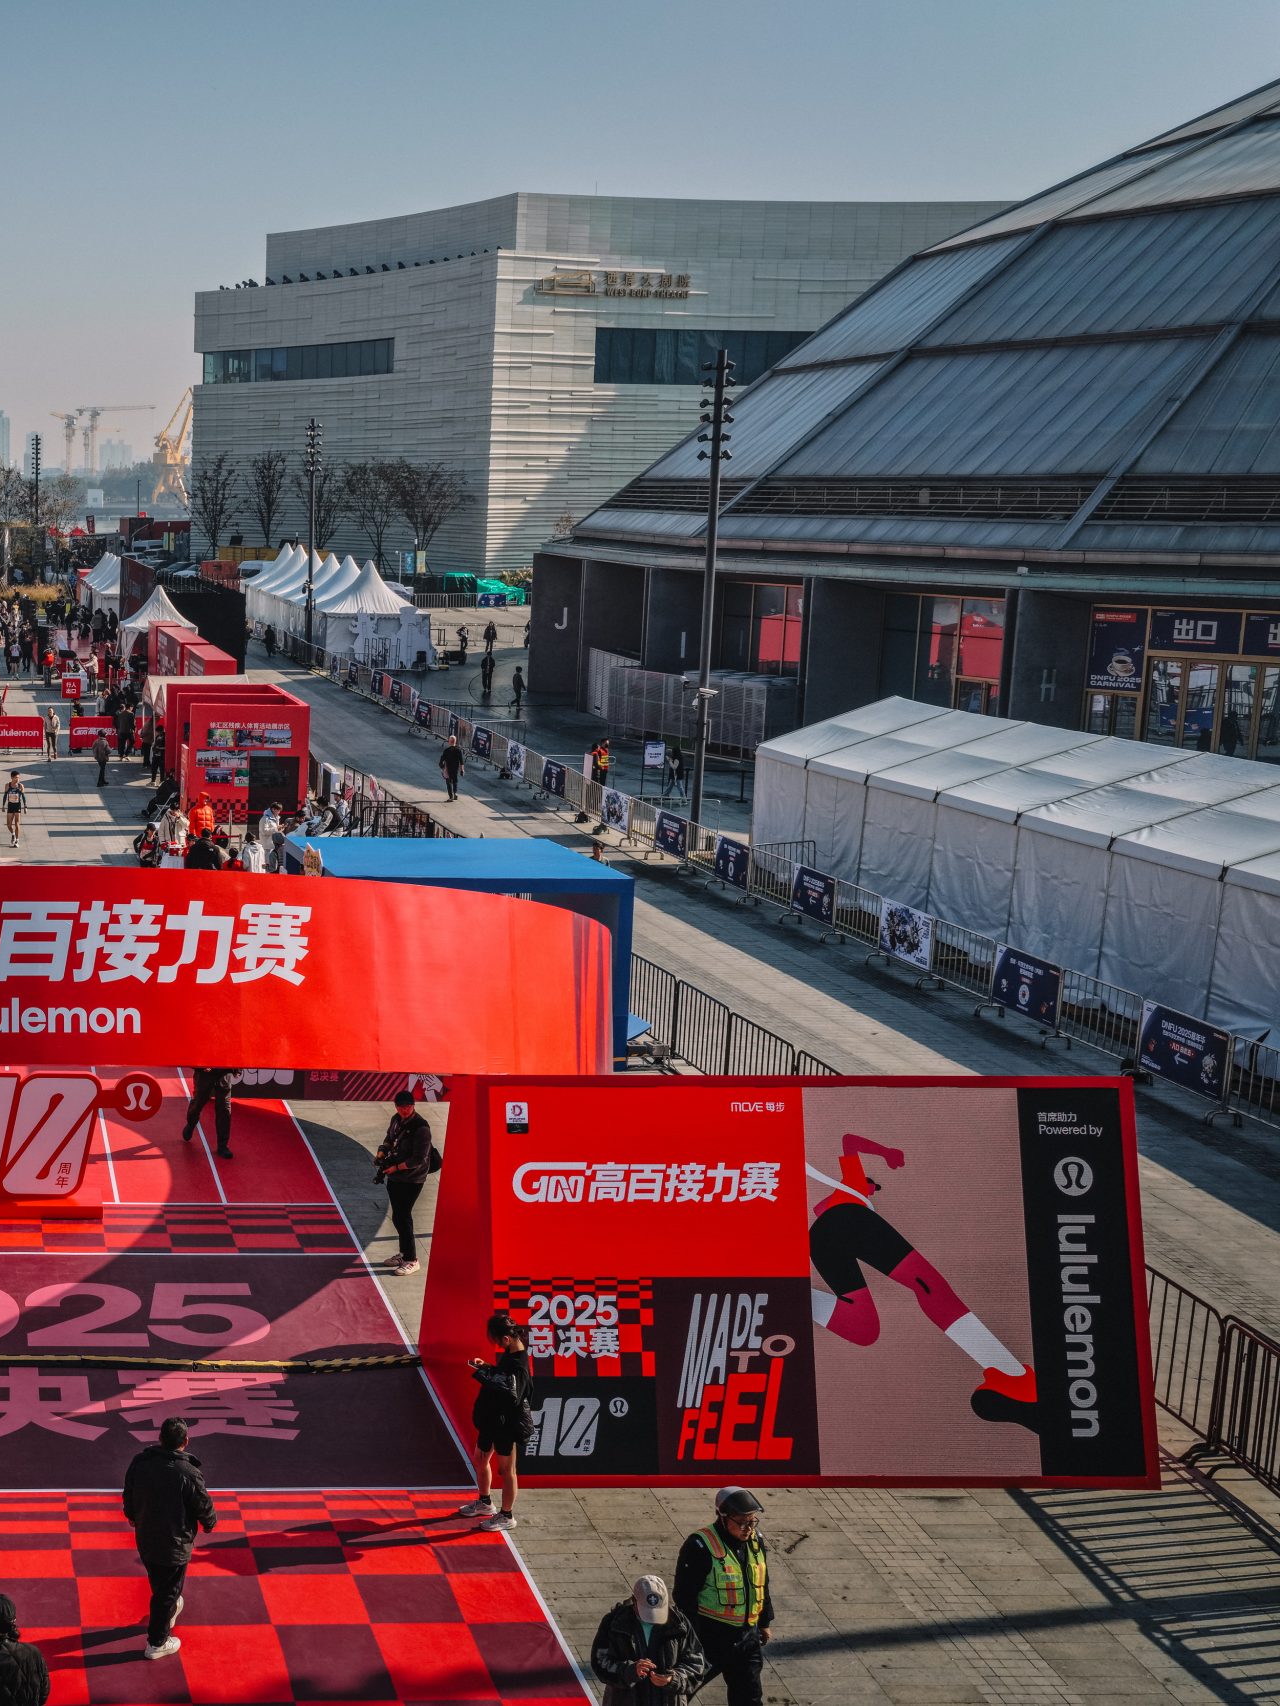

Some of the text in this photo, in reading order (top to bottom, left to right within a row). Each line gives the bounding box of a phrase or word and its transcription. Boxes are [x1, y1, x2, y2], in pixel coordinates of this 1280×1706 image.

[554, 607, 568, 630] J
[1173, 618, 1218, 641] 出口
[1090, 674, 1116, 682] DNFU
[1090, 681, 1137, 689] CARNIVAL
[730, 1101, 785, 1113] MOVE 每步
[1037, 1112, 1078, 1122] 首席助力
[1038, 1124, 1103, 1137] Powered by
[55, 1162, 72, 1189] 周年
[587, 1161, 781, 1203] 高百接力赛
[527, 1294, 619, 1326] 2025
[1057, 1214, 1101, 1438] lululemon
[526, 1327, 620, 1359] 总决赛
[676, 1293, 769, 1408] MADE
[676, 1357, 794, 1461] FEEL
